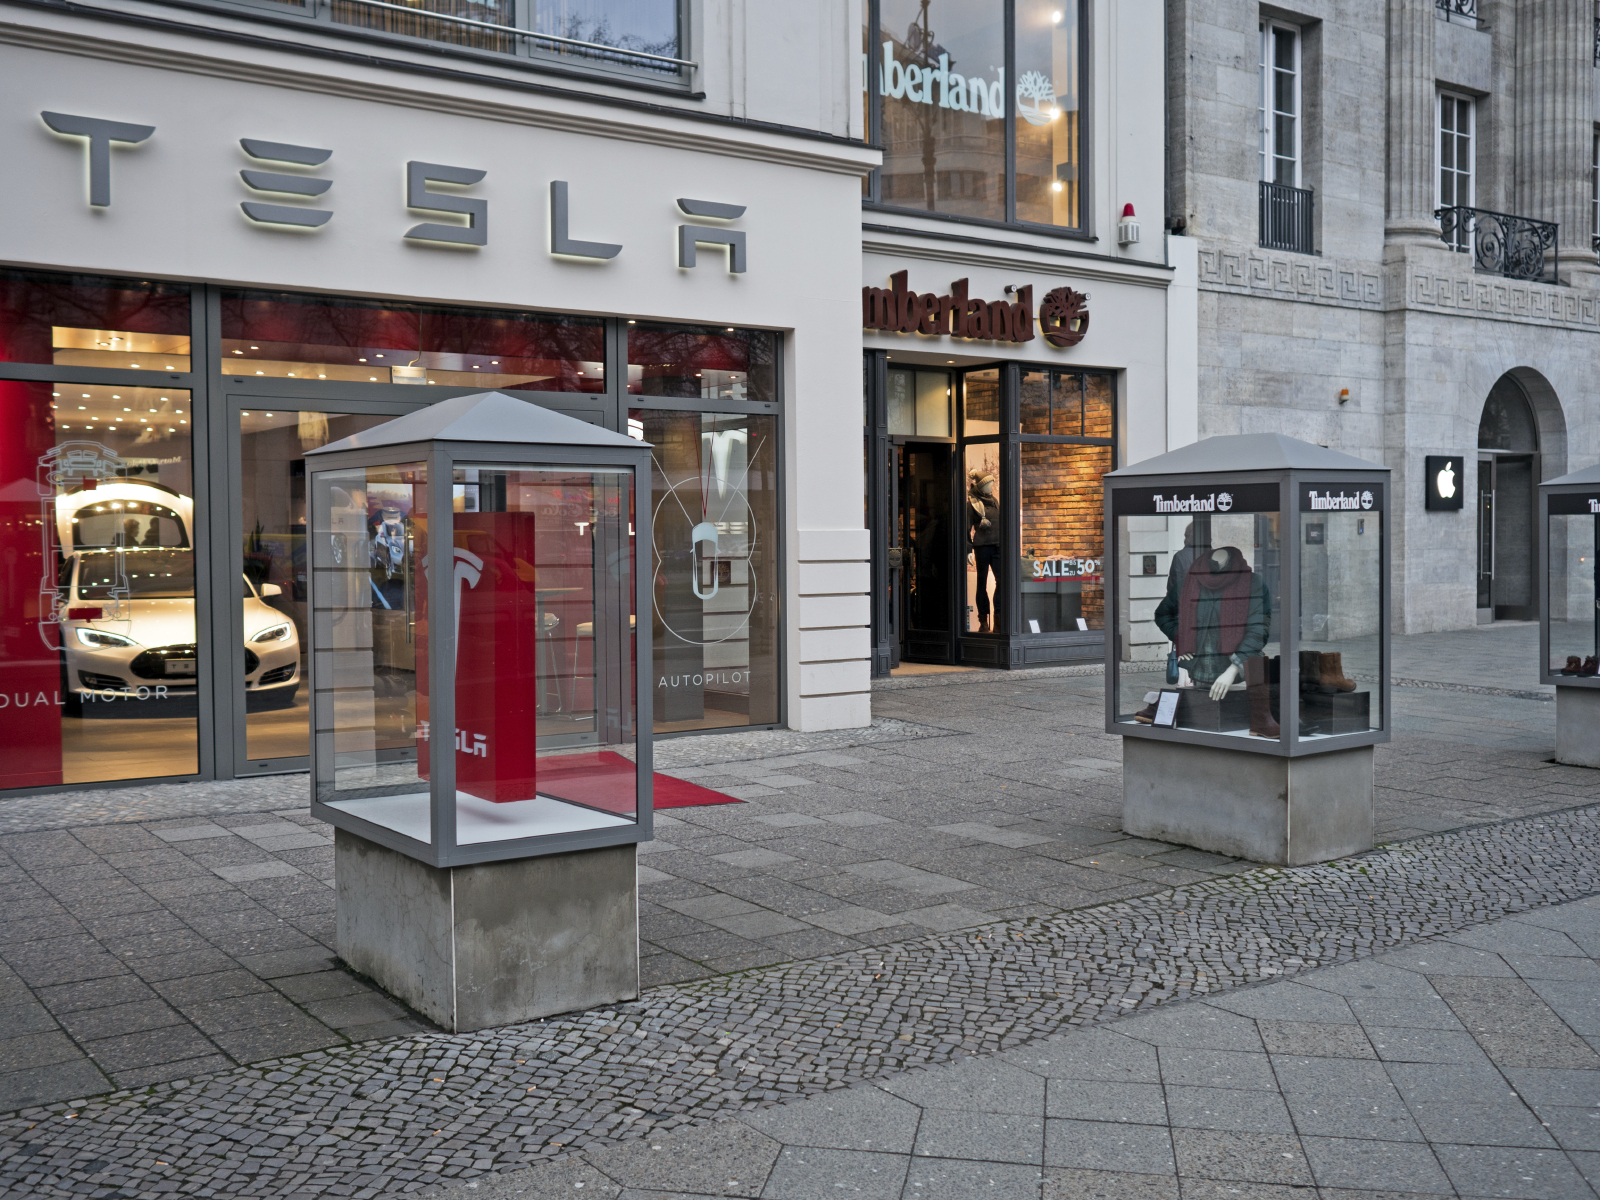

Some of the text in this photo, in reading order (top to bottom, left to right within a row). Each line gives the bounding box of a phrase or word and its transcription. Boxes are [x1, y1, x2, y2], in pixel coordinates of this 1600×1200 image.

[863, 40, 1005, 119] berland
[41, 110, 748, 273] TESLA
[863, 269, 1035, 342] mberland
[1153, 494, 1215, 512] Timberland
[1309, 490, 1360, 510] Timberland
[1033, 560, 1069, 577] SALE
[658, 671, 751, 688] AUTOPILOT
[80, 685, 168, 703] MOTOR
[420, 720, 486, 757] TLA
